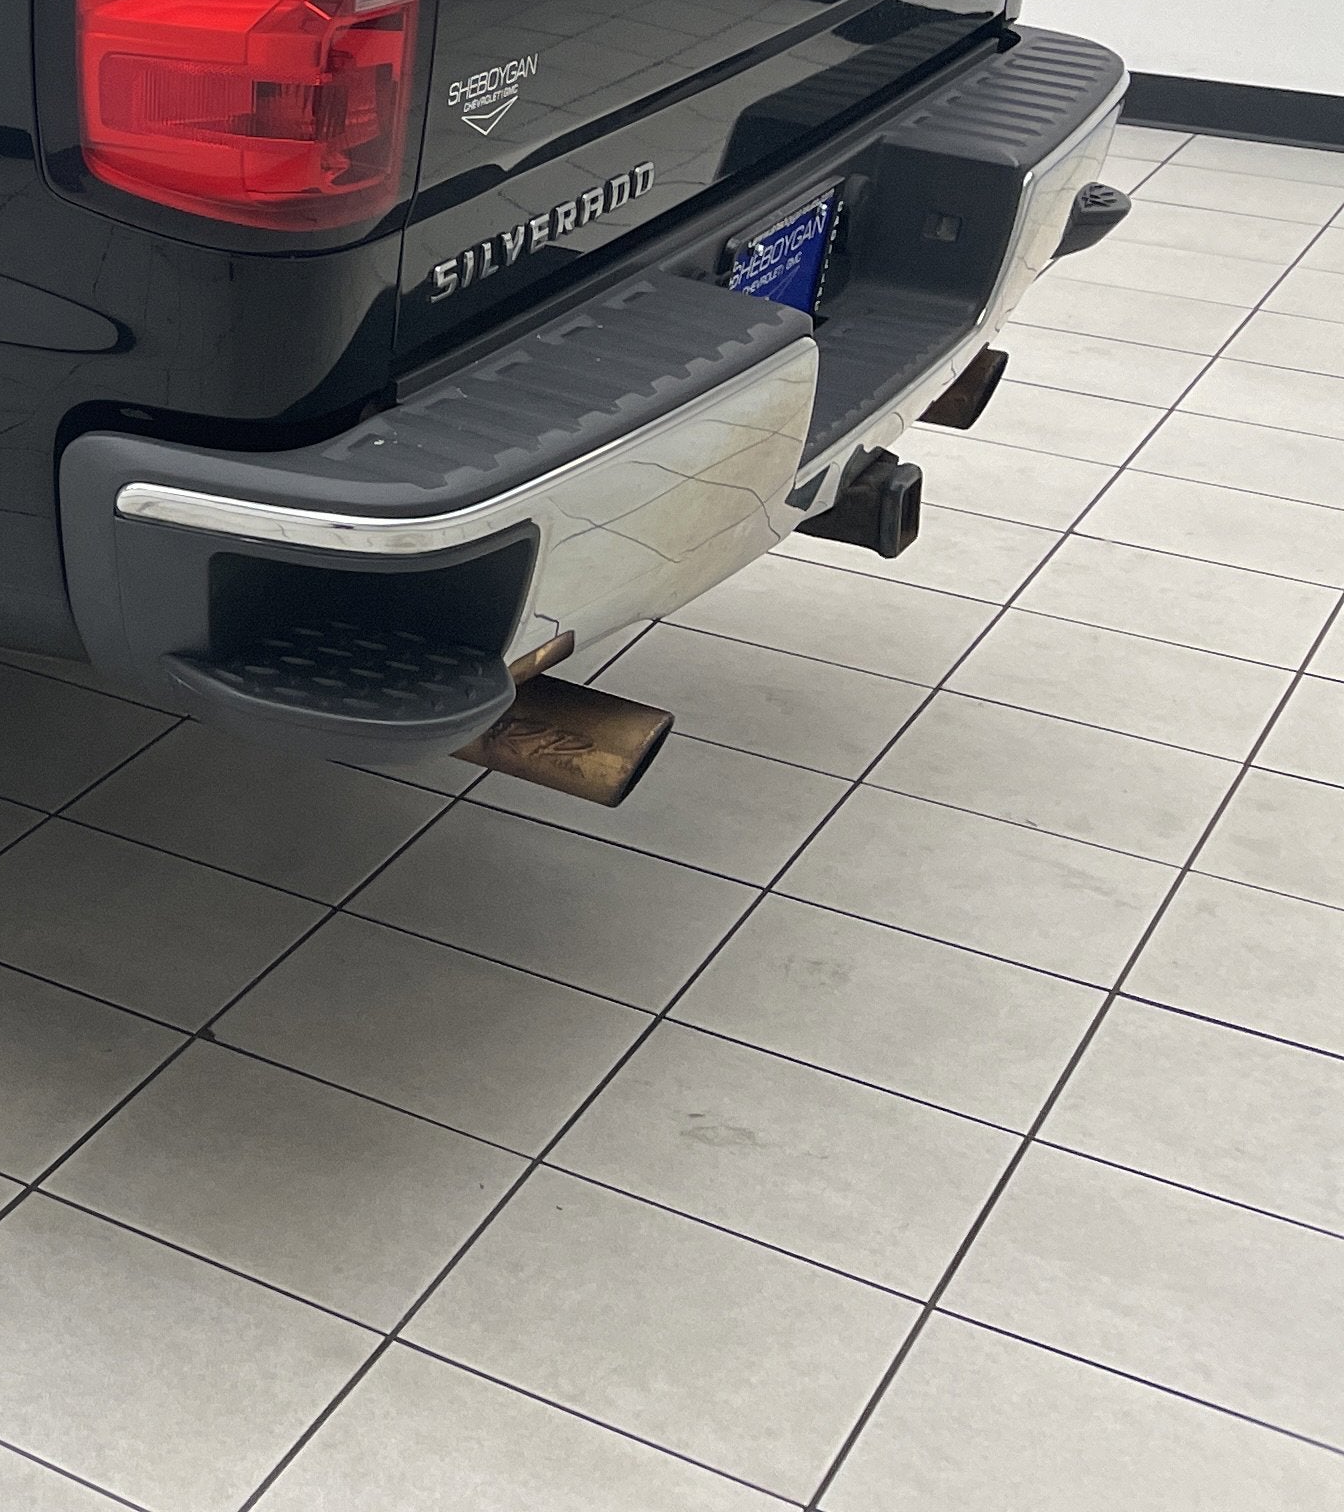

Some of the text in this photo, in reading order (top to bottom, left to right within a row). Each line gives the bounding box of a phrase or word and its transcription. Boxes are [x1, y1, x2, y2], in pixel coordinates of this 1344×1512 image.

[448, 53, 538, 106] SHEBOYGAN
[427, 160, 655, 303] SILVERADO
[729, 210, 828, 291] SHEBOYGAN
